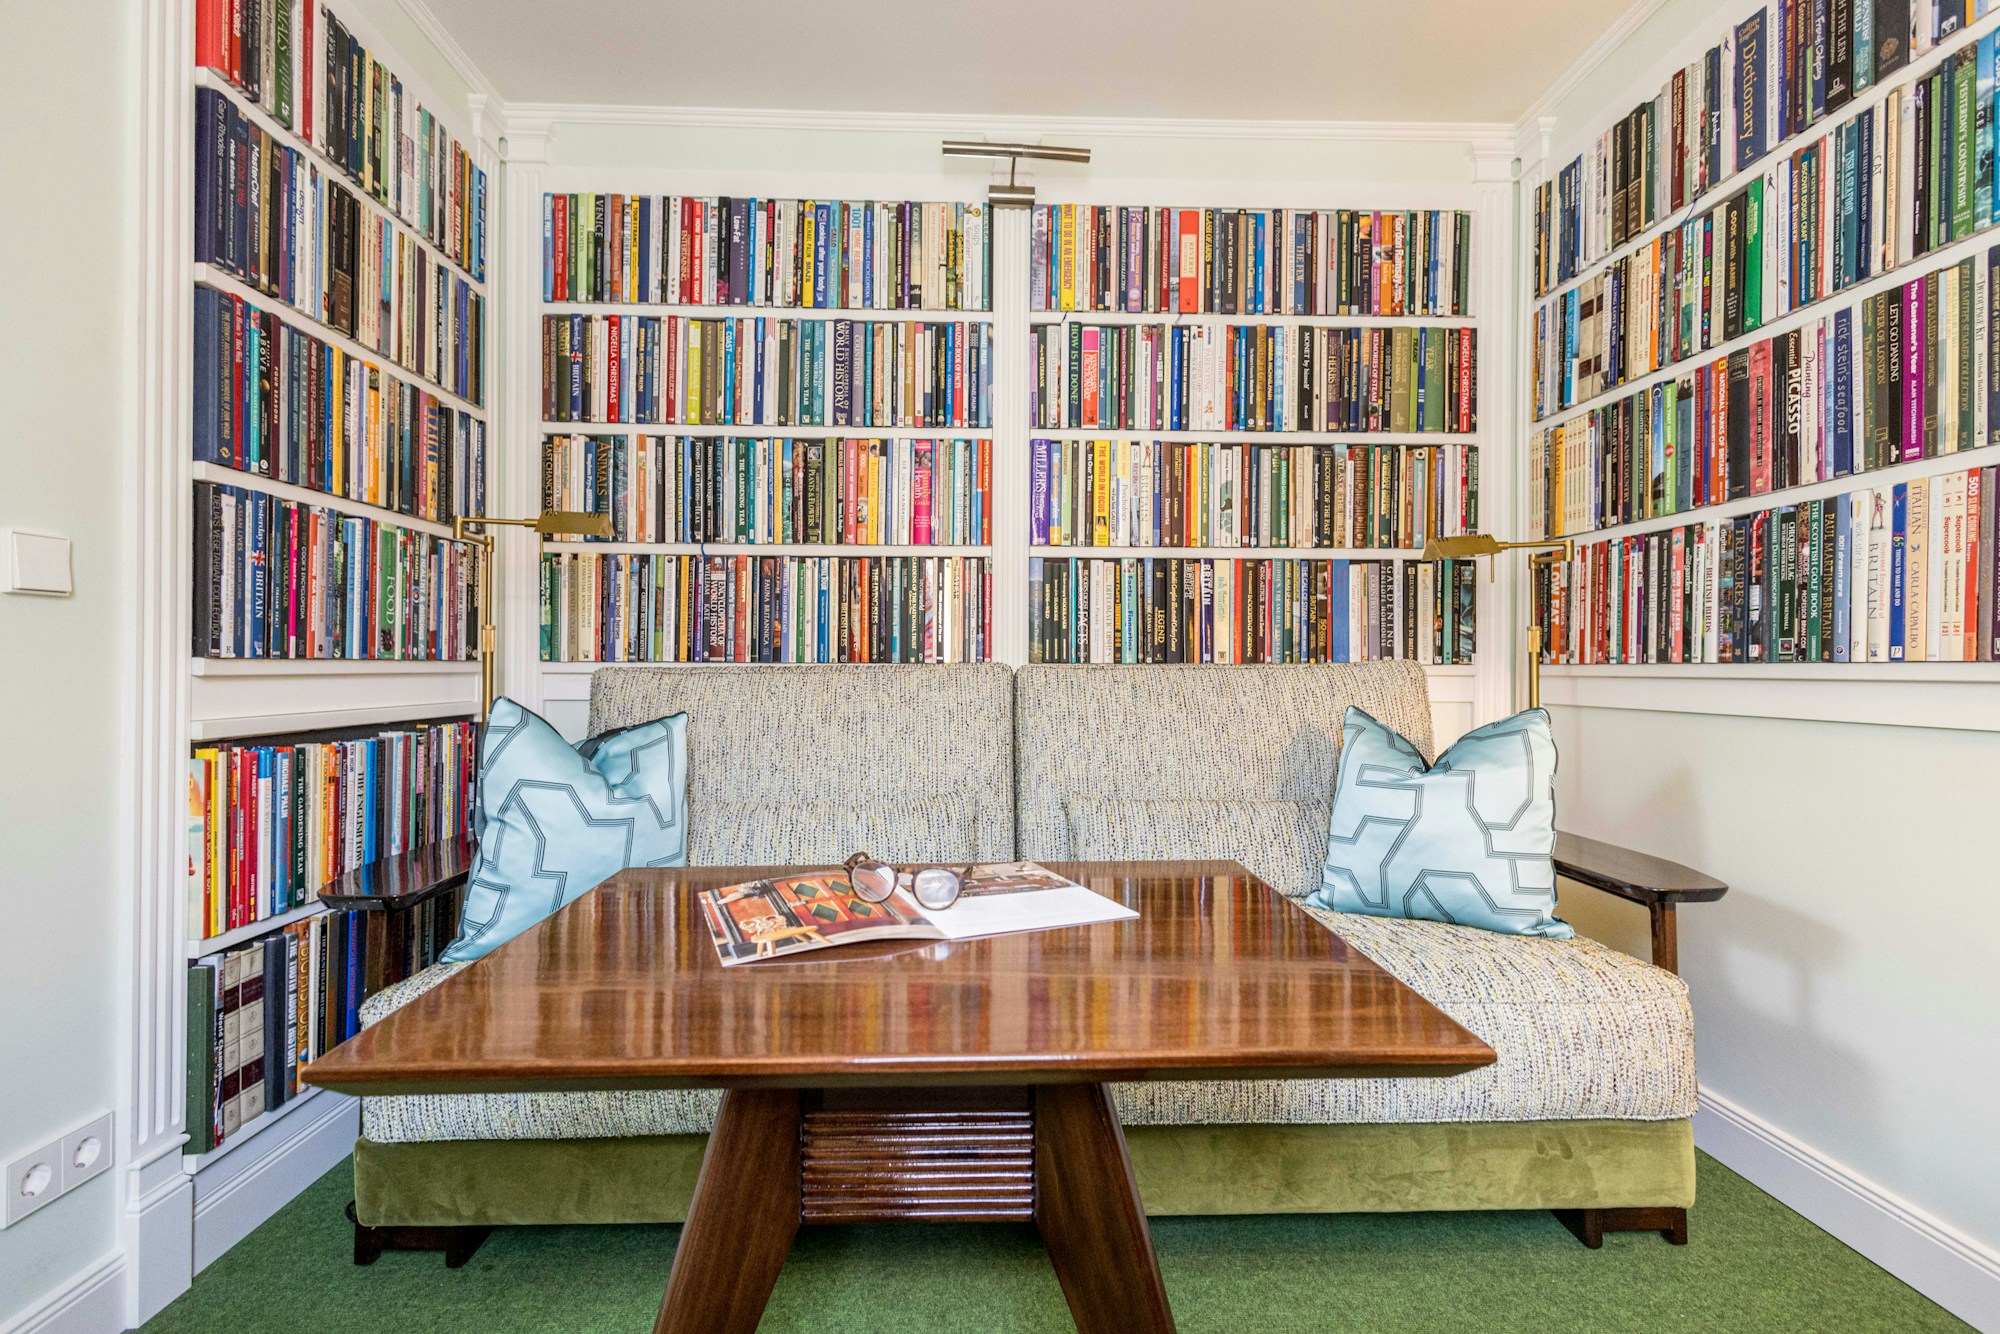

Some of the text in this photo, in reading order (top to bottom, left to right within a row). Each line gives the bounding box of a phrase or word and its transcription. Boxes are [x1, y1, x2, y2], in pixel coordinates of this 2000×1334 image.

[1837, 11, 1846, 63] THE LENS
[217, 99, 226, 120] Gary
[1740, 39, 1757, 140] Dictionary
[1957, 80, 1969, 209] YESTERDAY'S COUNTRYSIDE
[251, 144, 259, 206] MasterChef
[297, 190, 305, 224] design
[595, 200, 603, 238] VENICE
[852, 208, 861, 228] 1001
[1064, 204, 1072, 220] WHAT
[817, 276, 825, 291] body
[1064, 257, 1072, 290] EMERGENCY
[1071, 350, 1078, 359] IS
[1876, 296, 1886, 384] TOWER OF LONDON
[835, 323, 844, 407] WORLD HISTORY
[1071, 362, 1078, 370] IT
[1328, 356, 1336, 383] HERBS
[1788, 332, 1801, 434] Essential PICASSO
[1837, 318, 1849, 434] rick stein's seafood
[1718, 436, 1725, 447] OF
[597, 442, 612, 496] ANIMALS
[1098, 460, 1106, 482] WORLD
[1968, 476, 1978, 496] 500
[1324, 494, 1330, 504] OF
[1912, 486, 1922, 534] ITALIAN
[1968, 497, 1977, 514] SLOW
[1811, 522, 1819, 565] SCOTTISH
[1967, 516, 1976, 542] COOKING
[1202, 564, 1210, 604] BRITAIN
[1734, 527, 1745, 606] TREASURES
[1822, 513, 1834, 639] PAUL MARTIN'S BRITAIN
[1868, 543, 1878, 620] BRITAIN
[212, 585, 220, 639] COLLECTION
[255, 571, 263, 618] BRITAIN
[386, 575, 395, 624] FOOD
[1810, 593, 1818, 618] BOOK
[1910, 601, 1918, 649] CAPALBO
[281, 794, 289, 818] PALIN
[356, 795, 364, 838] ENGLISH
[288, 939, 298, 1067] THE TRUTH ABOUT HISTORY
